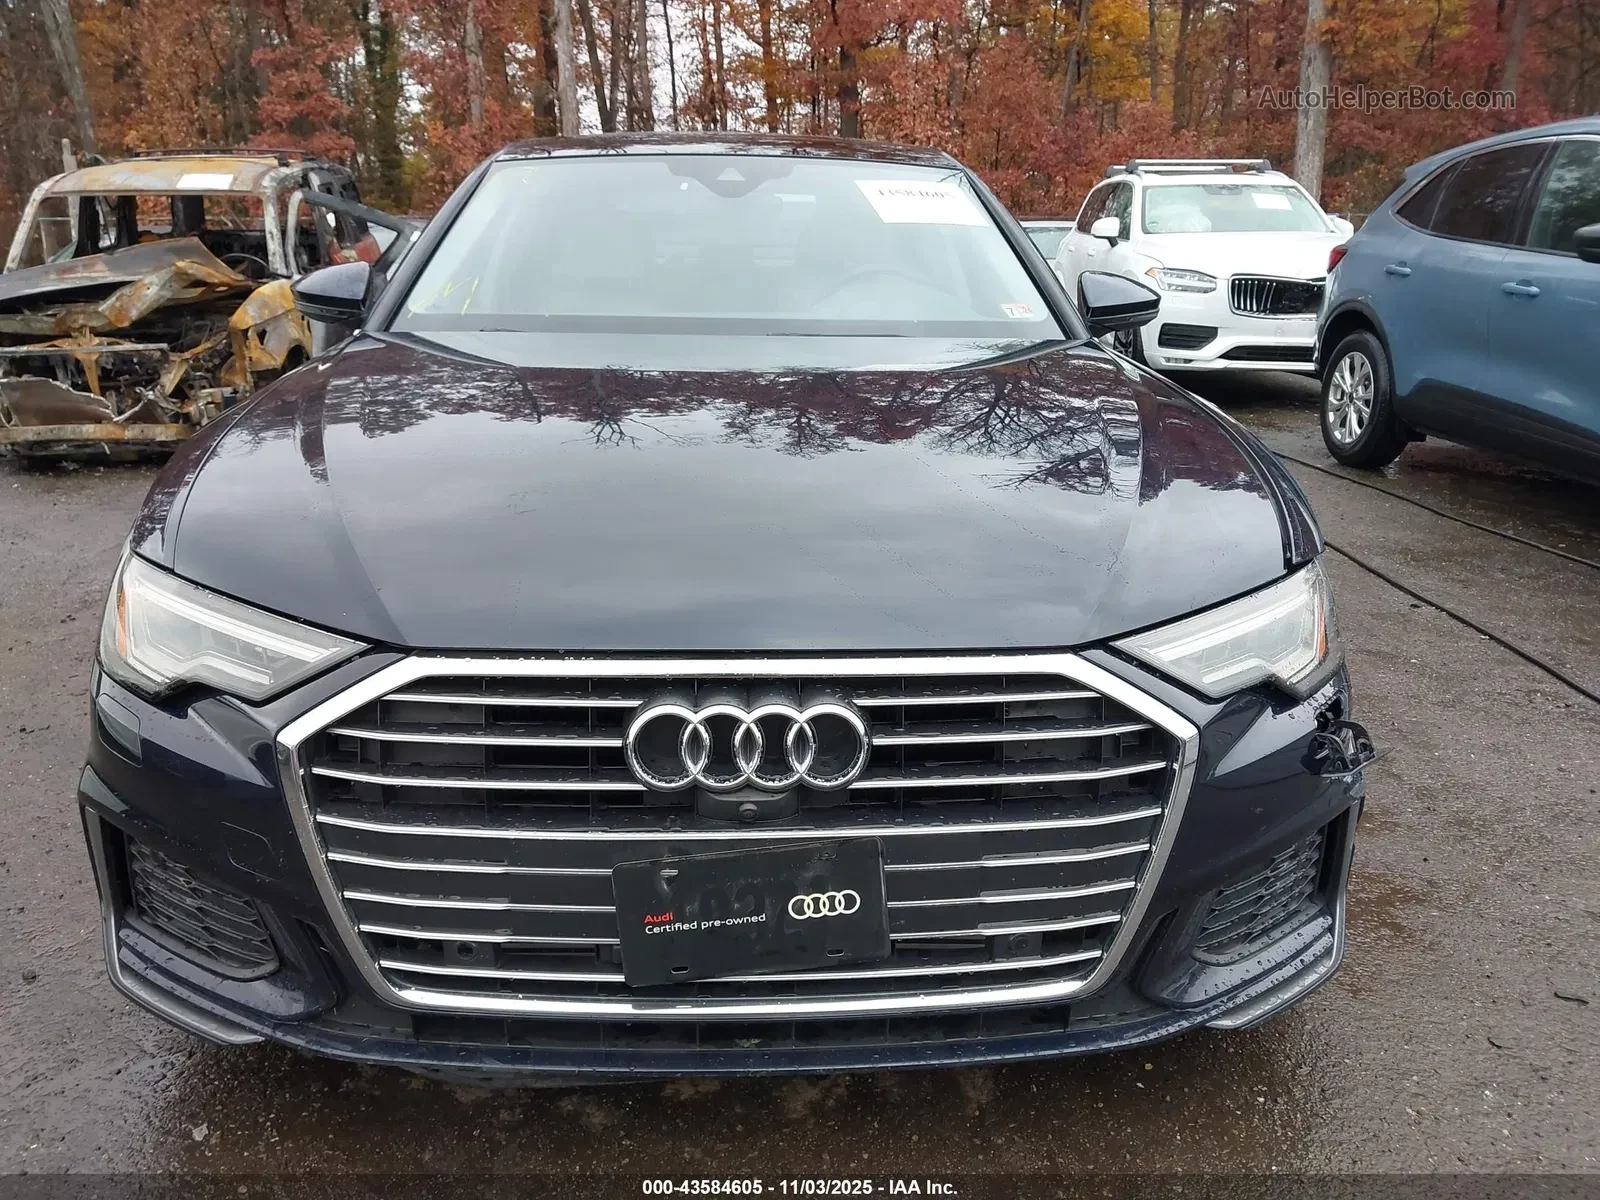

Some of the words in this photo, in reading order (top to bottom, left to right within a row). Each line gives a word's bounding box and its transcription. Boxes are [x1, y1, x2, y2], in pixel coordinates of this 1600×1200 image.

[644, 911, 674, 924] Audi
[645, 920, 698, 935] Certified
[701, 913, 766, 930] pre-owned
